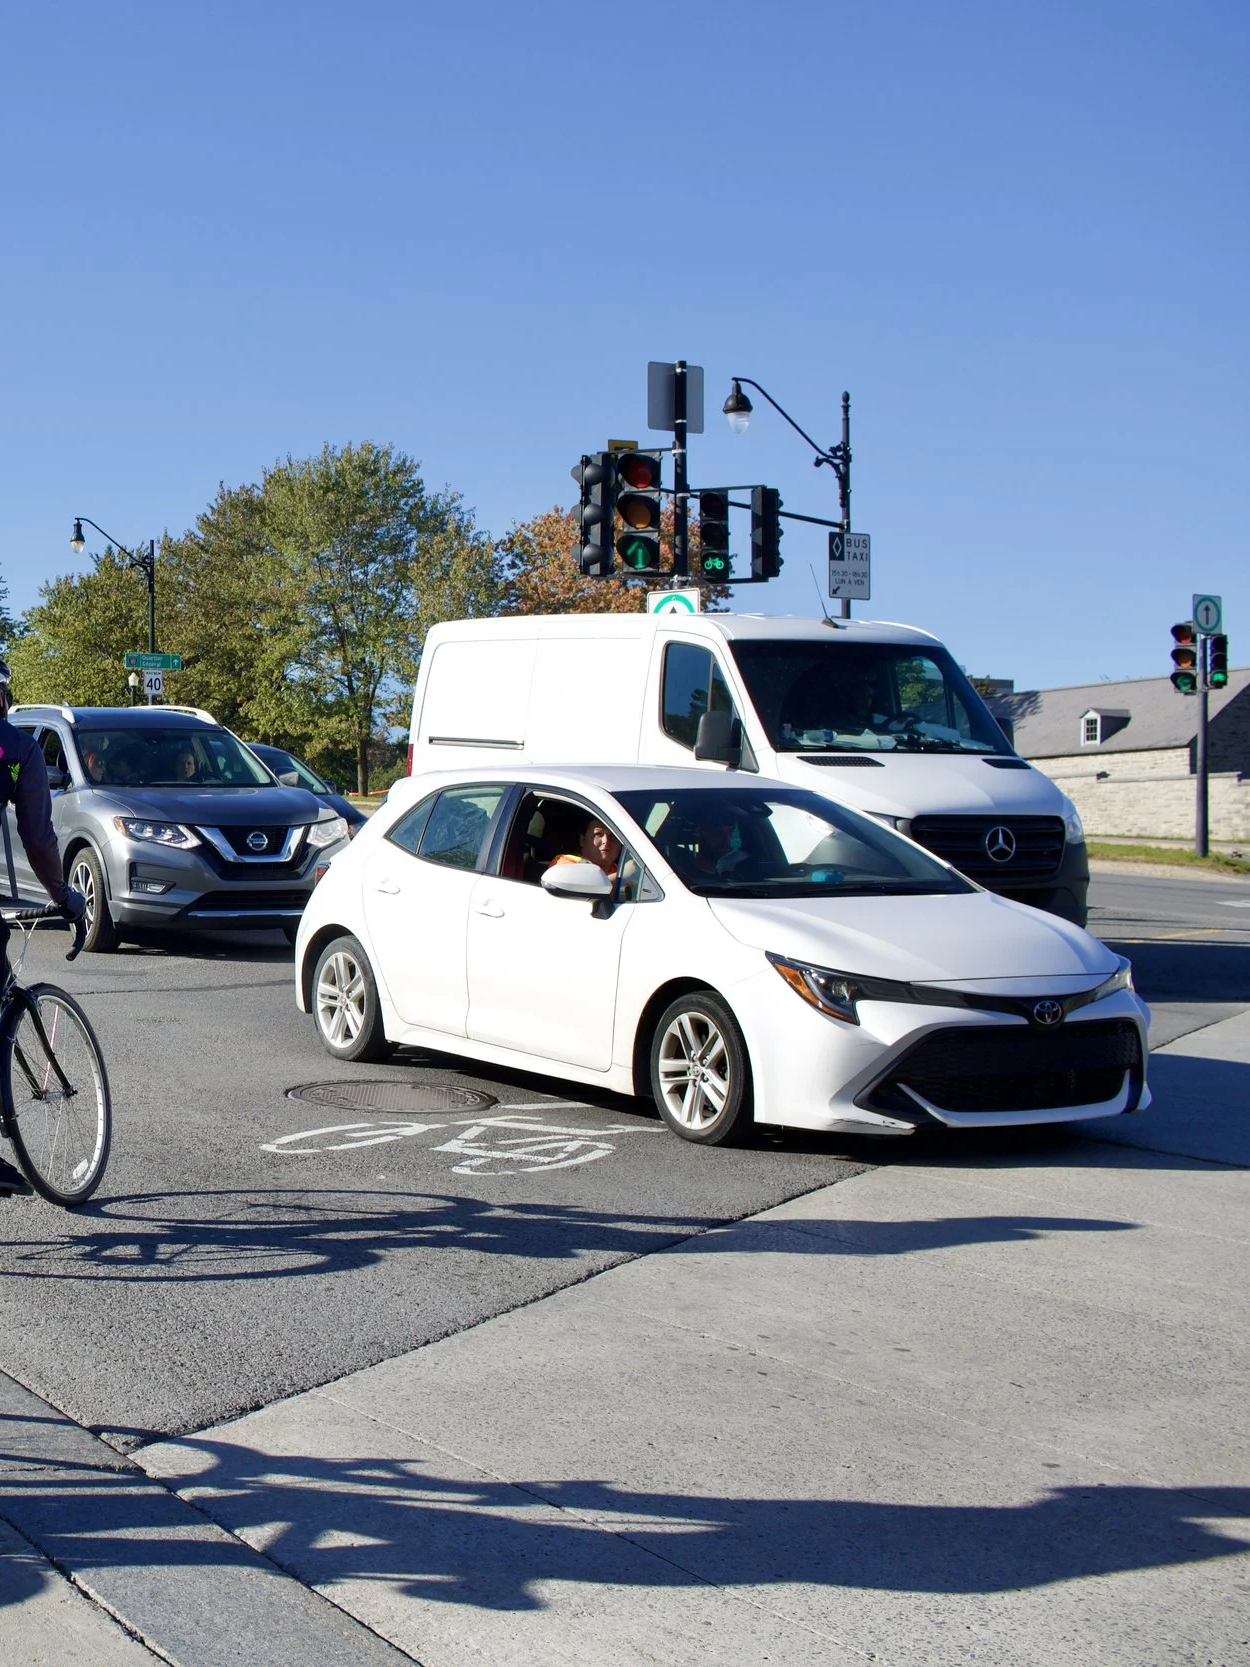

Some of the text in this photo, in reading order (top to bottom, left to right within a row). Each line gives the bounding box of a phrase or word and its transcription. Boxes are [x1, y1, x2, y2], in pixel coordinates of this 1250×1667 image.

[846, 538, 868, 549] BUS
[846, 551, 868, 561] TAXI
[146, 677, 161, 690] 40
